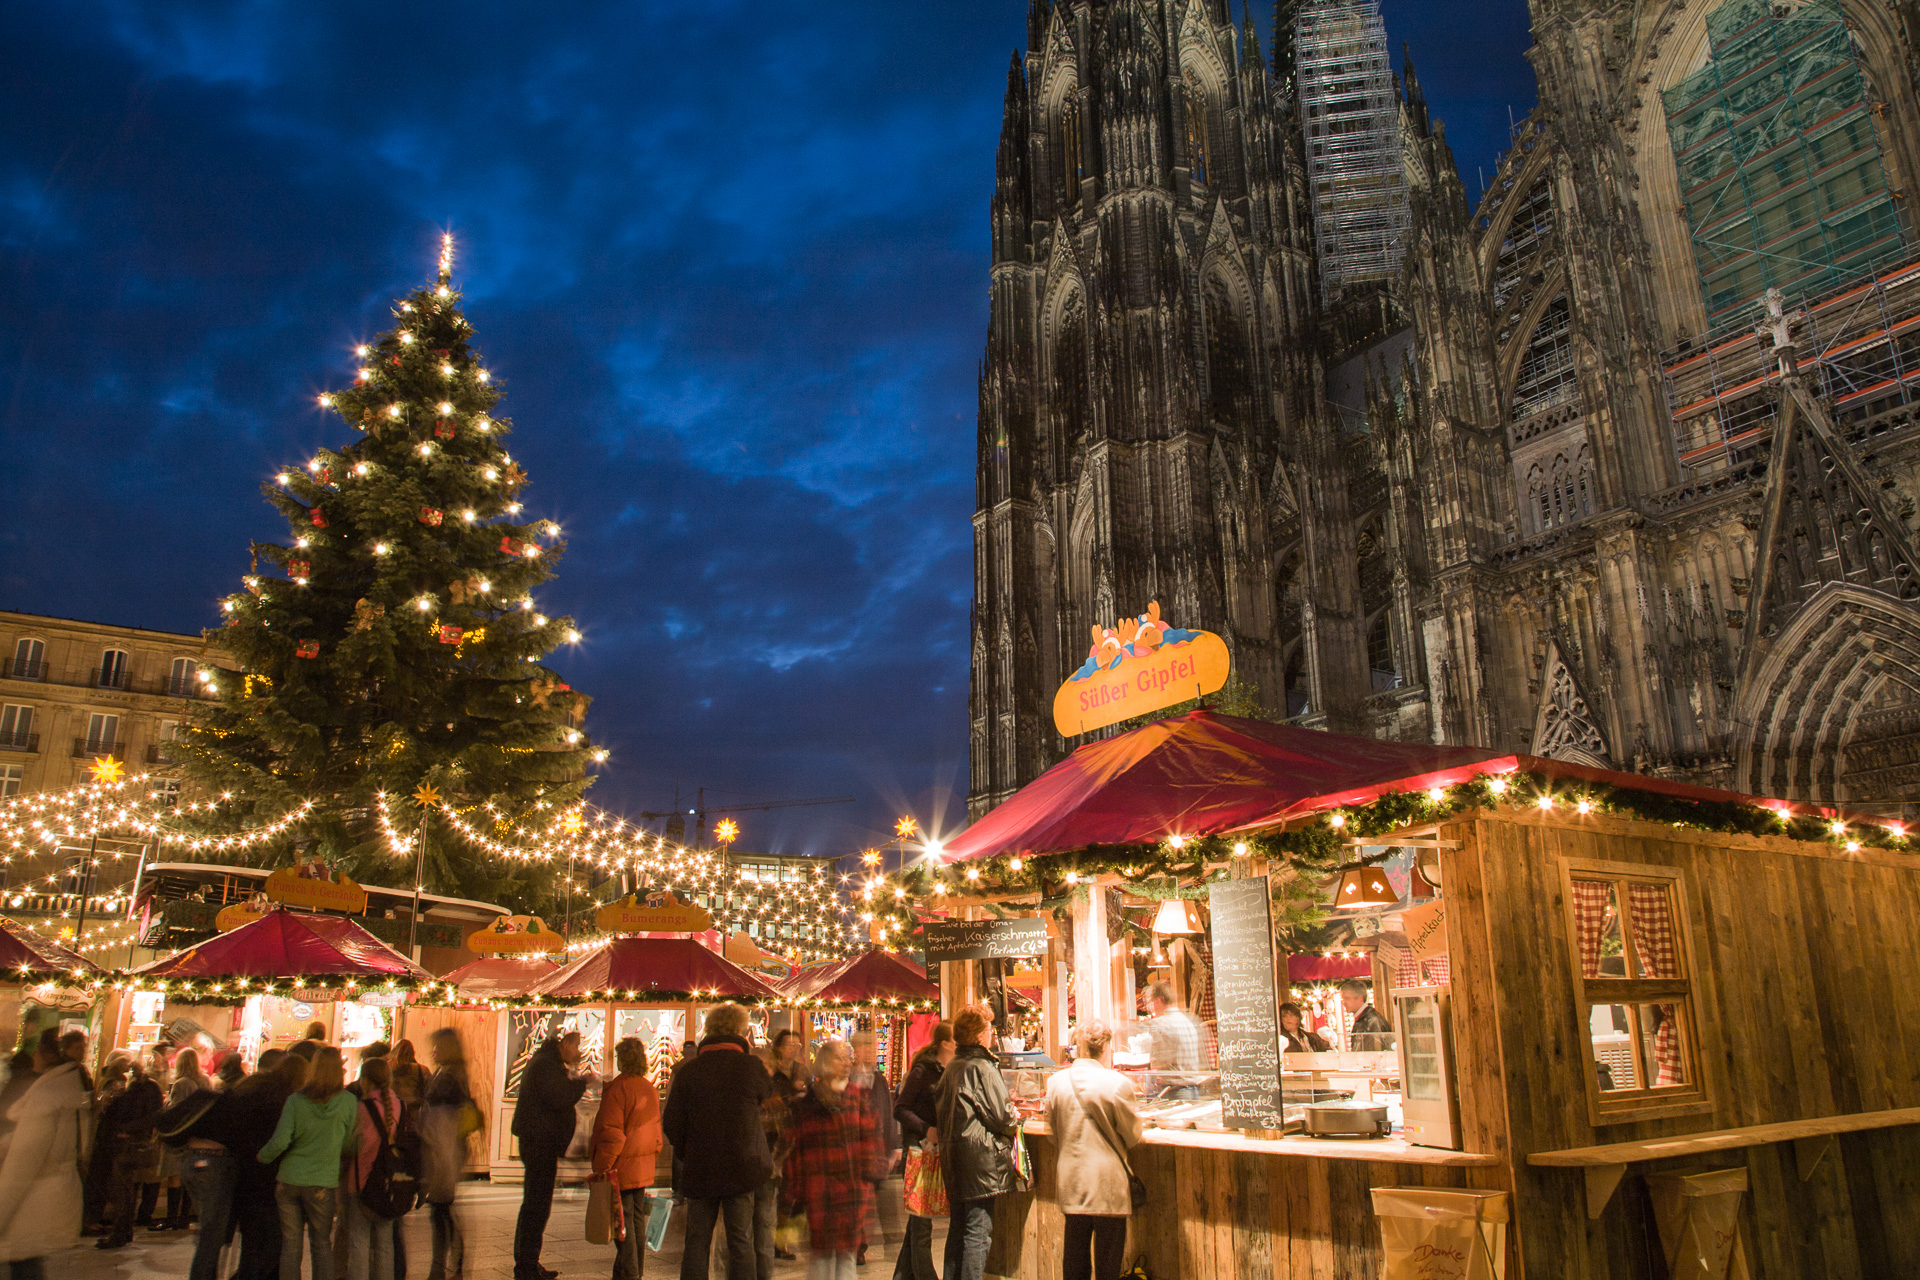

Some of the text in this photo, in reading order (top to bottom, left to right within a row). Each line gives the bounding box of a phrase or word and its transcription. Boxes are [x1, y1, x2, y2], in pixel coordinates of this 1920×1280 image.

[1079, 654, 1196, 712] Süßer Gipfel
[273, 879, 360, 902] Punsch & Getränke
[622, 913, 687, 925] Bumerangs
[959, 920, 972, 929] bei
[504, 937, 523, 946] beim
[526, 937, 561, 947] Nikolaus
[926, 928, 1048, 944] frischer Kaiserschmarrn
[929, 944, 945, 952] mit
[947, 941, 983, 953] Apfelmus
[985, 941, 1020, 957] Portion
[1222, 1092, 1276, 1112] Bratapfel
[1413, 1244, 1466, 1263] Danke
